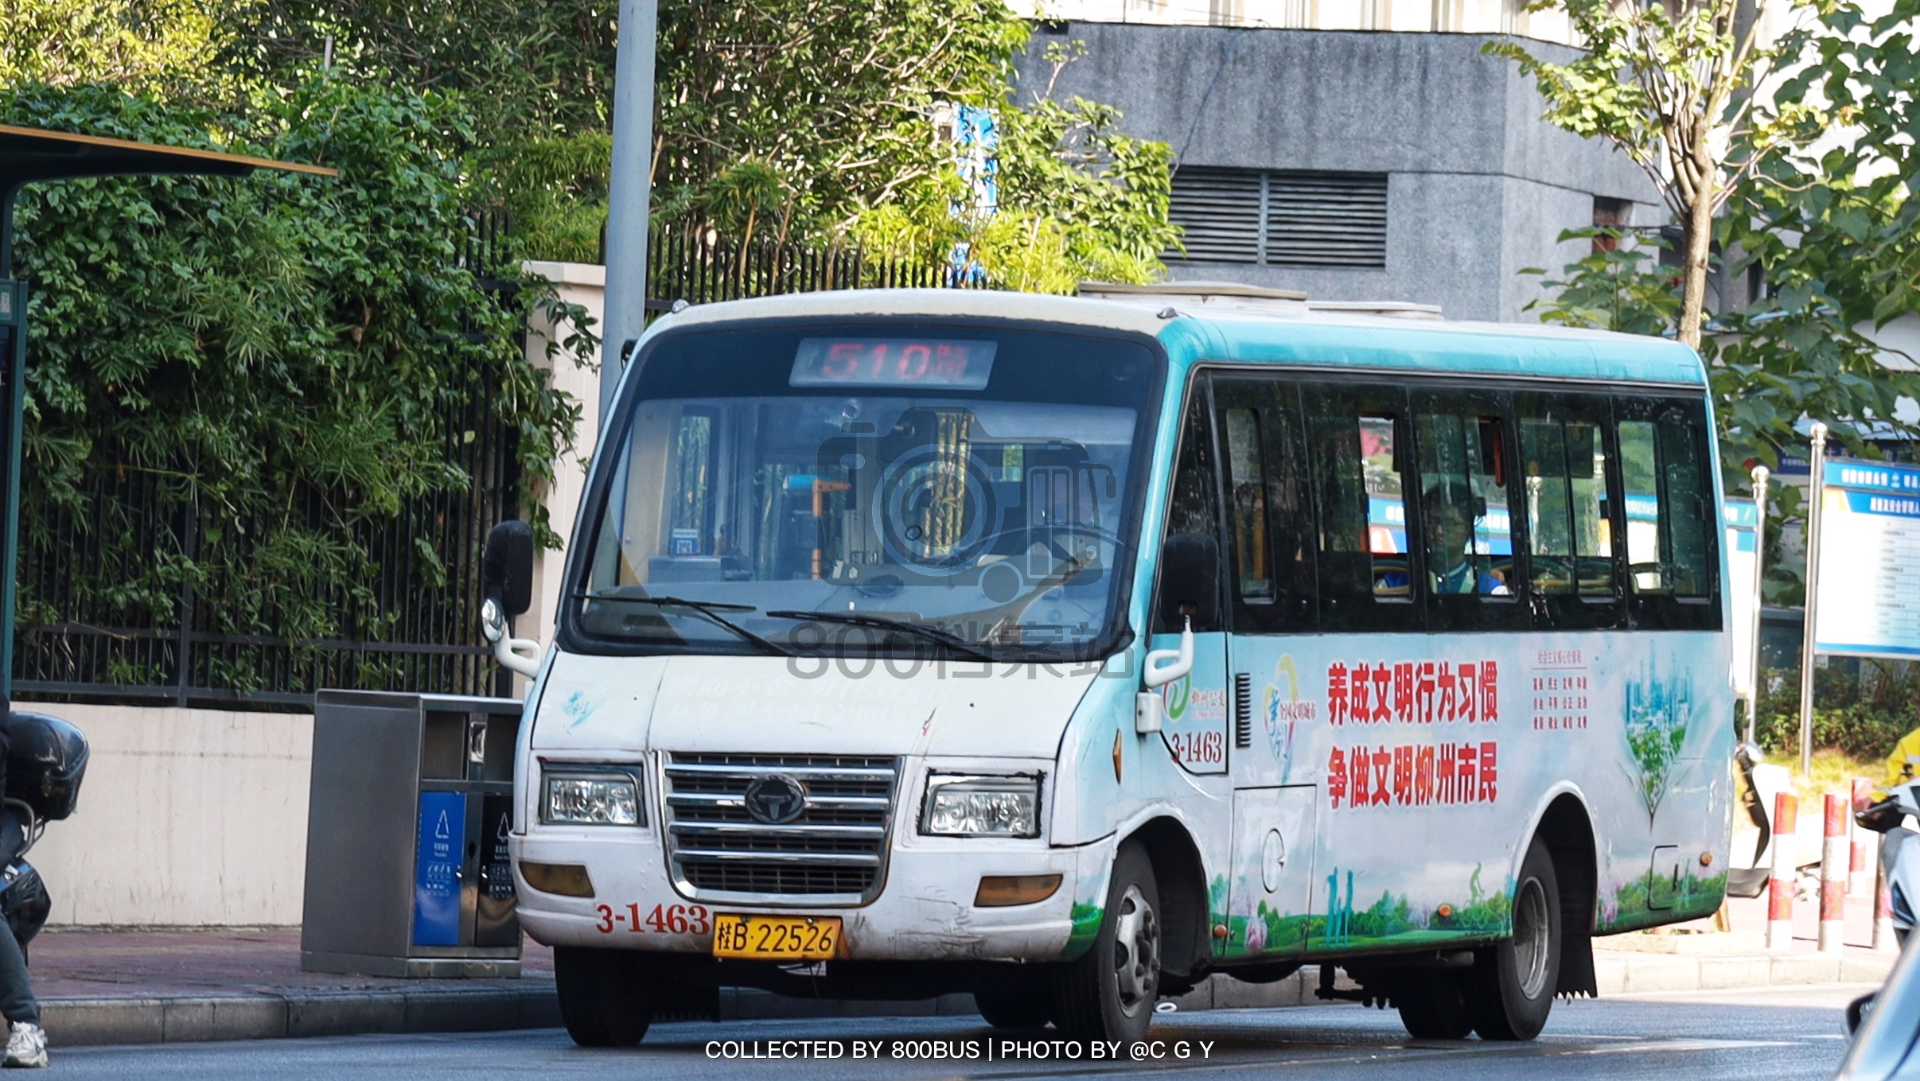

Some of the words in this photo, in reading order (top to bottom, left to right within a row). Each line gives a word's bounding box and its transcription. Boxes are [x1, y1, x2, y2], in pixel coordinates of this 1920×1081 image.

[1328, 660, 1498, 726] 养成文明行为习惯
[1171, 731, 1222, 763] 3-1463
[1328, 742, 1498, 810] 争做文明柳州市民
[596, 903, 710, 935] 3-1463
